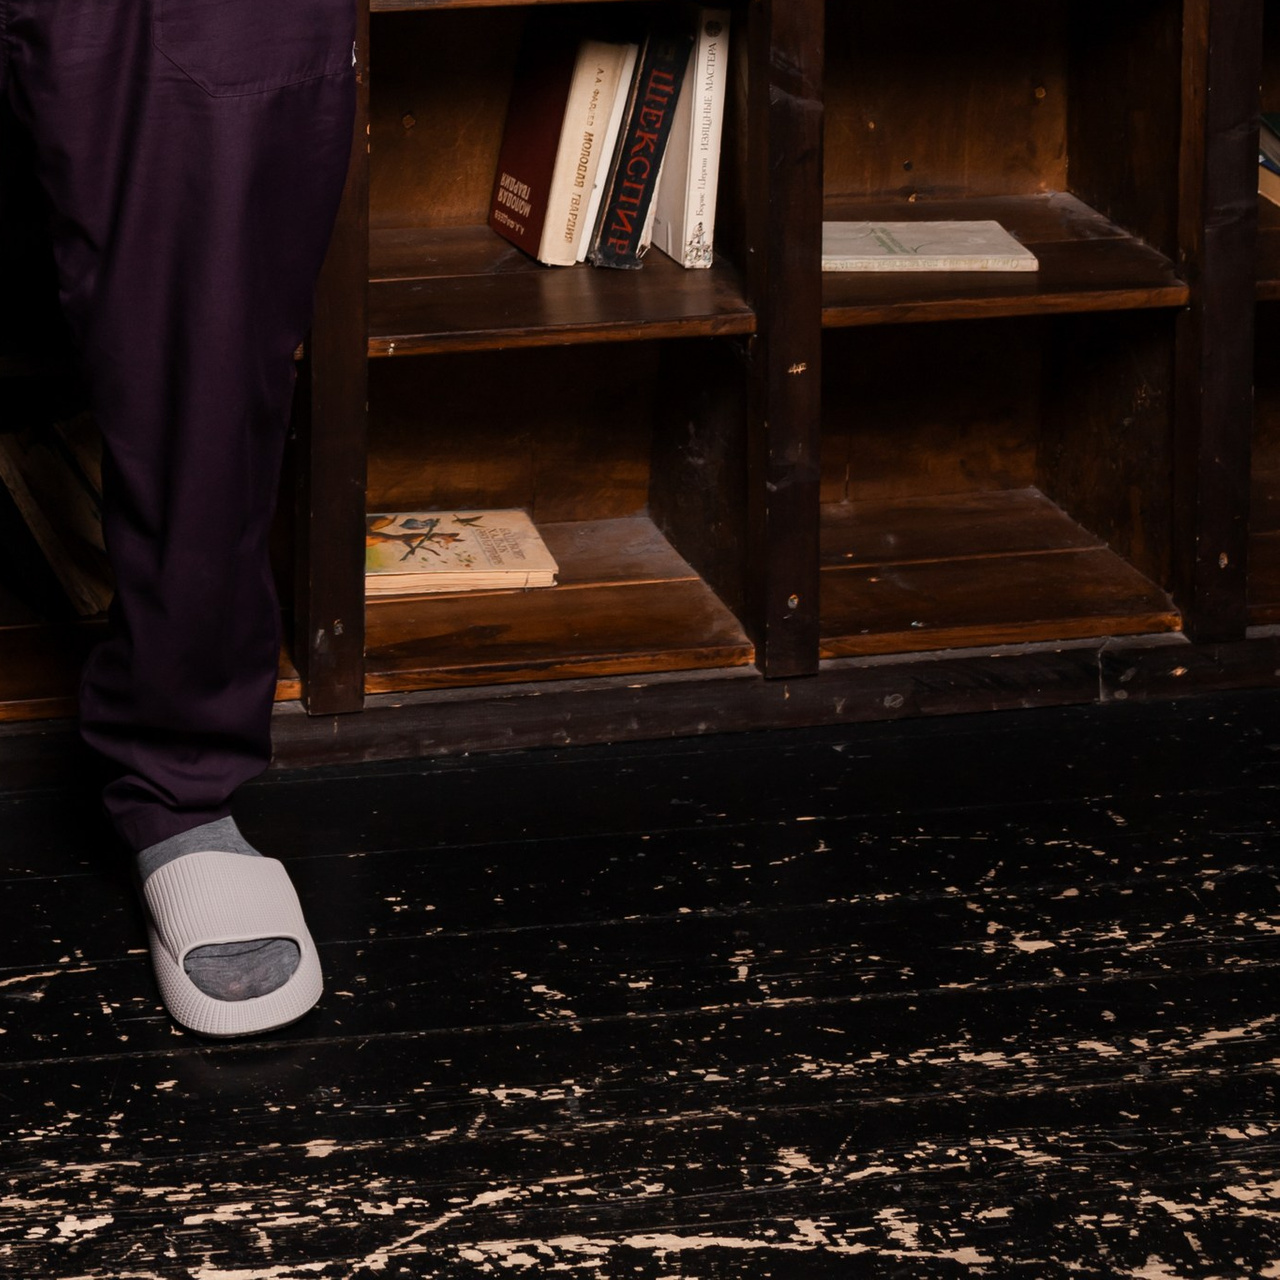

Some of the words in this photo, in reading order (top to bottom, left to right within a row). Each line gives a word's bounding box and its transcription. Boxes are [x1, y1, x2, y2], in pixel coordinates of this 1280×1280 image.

[704, 41, 718, 91] МАСТЕРА
[699, 94, 714, 150] ИЗЯЩНЫЕ
[500, 171, 531, 197] ГВАРДИЯ
[572, 131, 594, 189] МОЛОДАЯ
[608, 66, 674, 257] ШЕКСПИР
[497, 188, 532, 217] МОЛОДАЯ
[561, 192, 582, 245] ГВАРДИЯ
[694, 191, 706, 216] Борис
